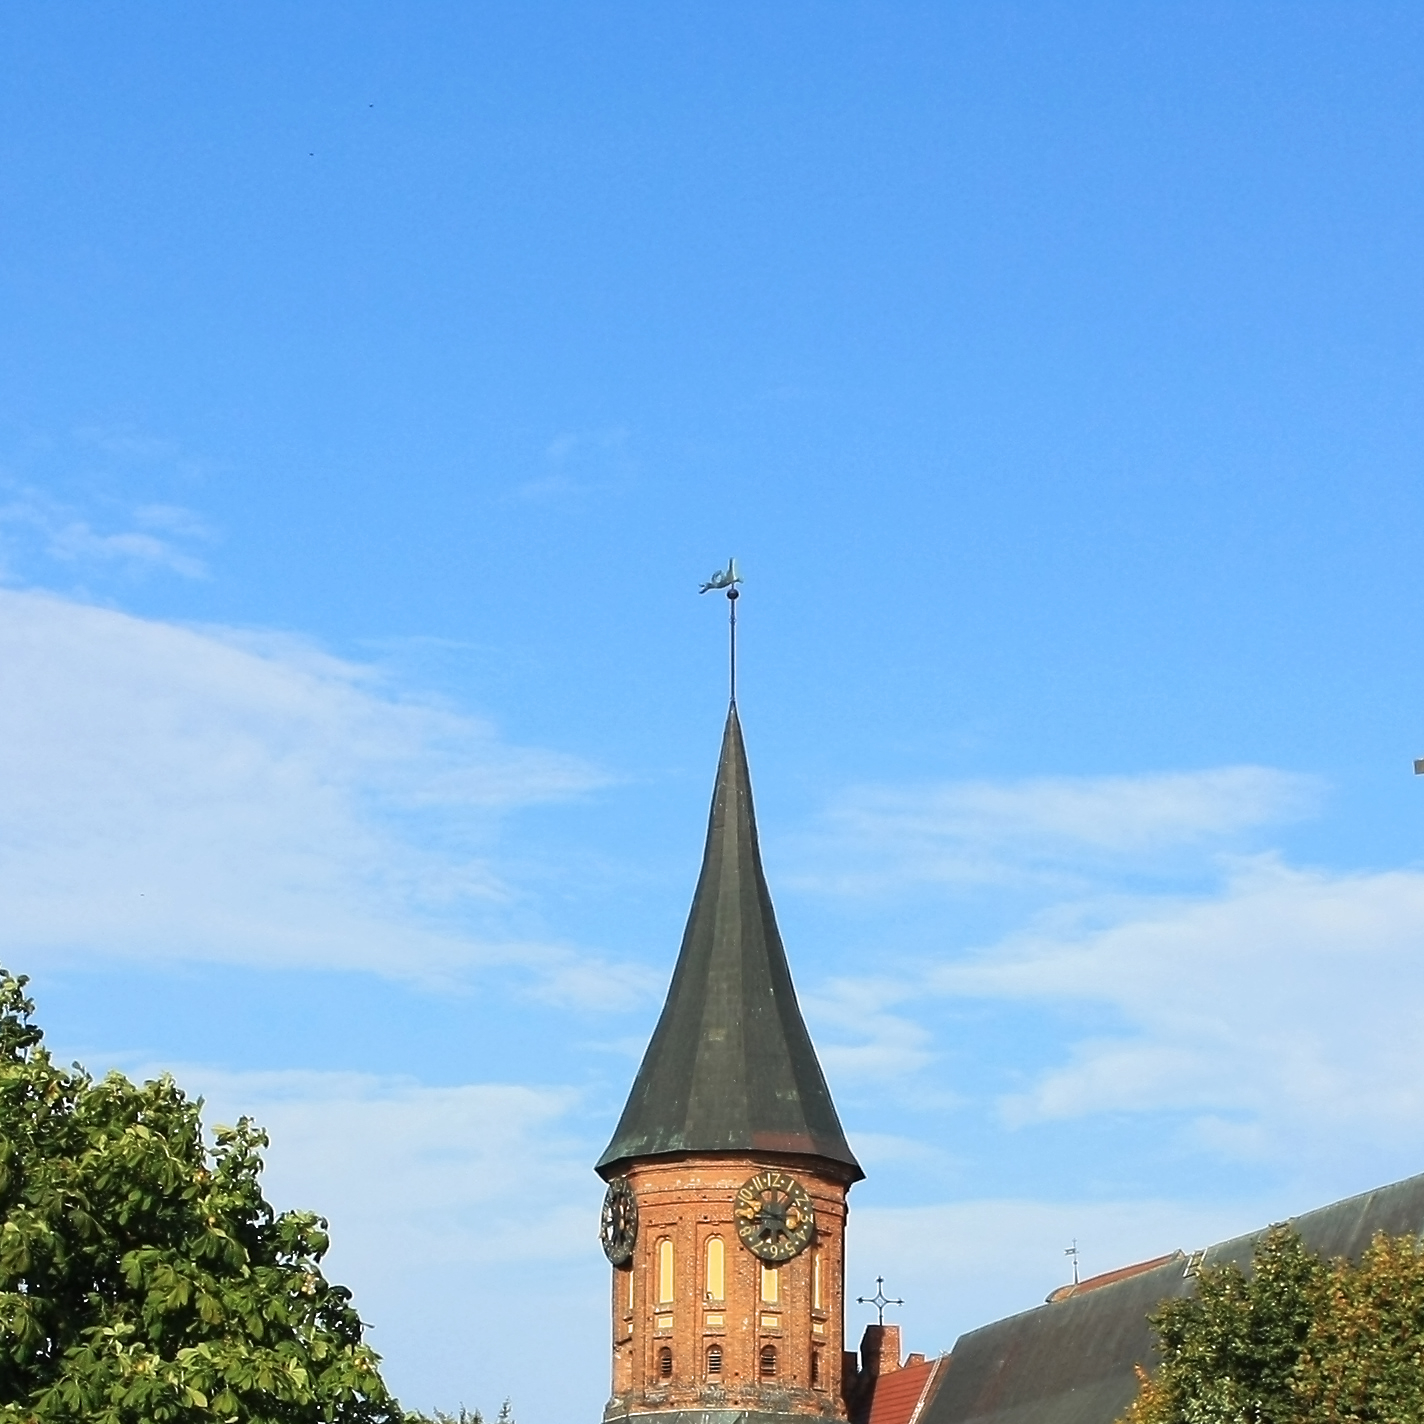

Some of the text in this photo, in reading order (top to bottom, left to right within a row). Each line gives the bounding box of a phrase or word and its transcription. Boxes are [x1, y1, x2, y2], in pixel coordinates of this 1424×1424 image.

[752, 1175, 763, 1191] 11
[767, 1173, 781, 1187] 12
[786, 1180, 795, 1192] 1
[737, 1188, 753, 1203] 10
[795, 1193, 810, 1207] 2
[800, 1213, 814, 1224] 3
[739, 1226, 752, 1237] 8
[796, 1229, 807, 1241] 4
[751, 1240, 764, 1254] 7
[770, 1245, 778, 1259] 6
[785, 1241, 796, 1256] 5
